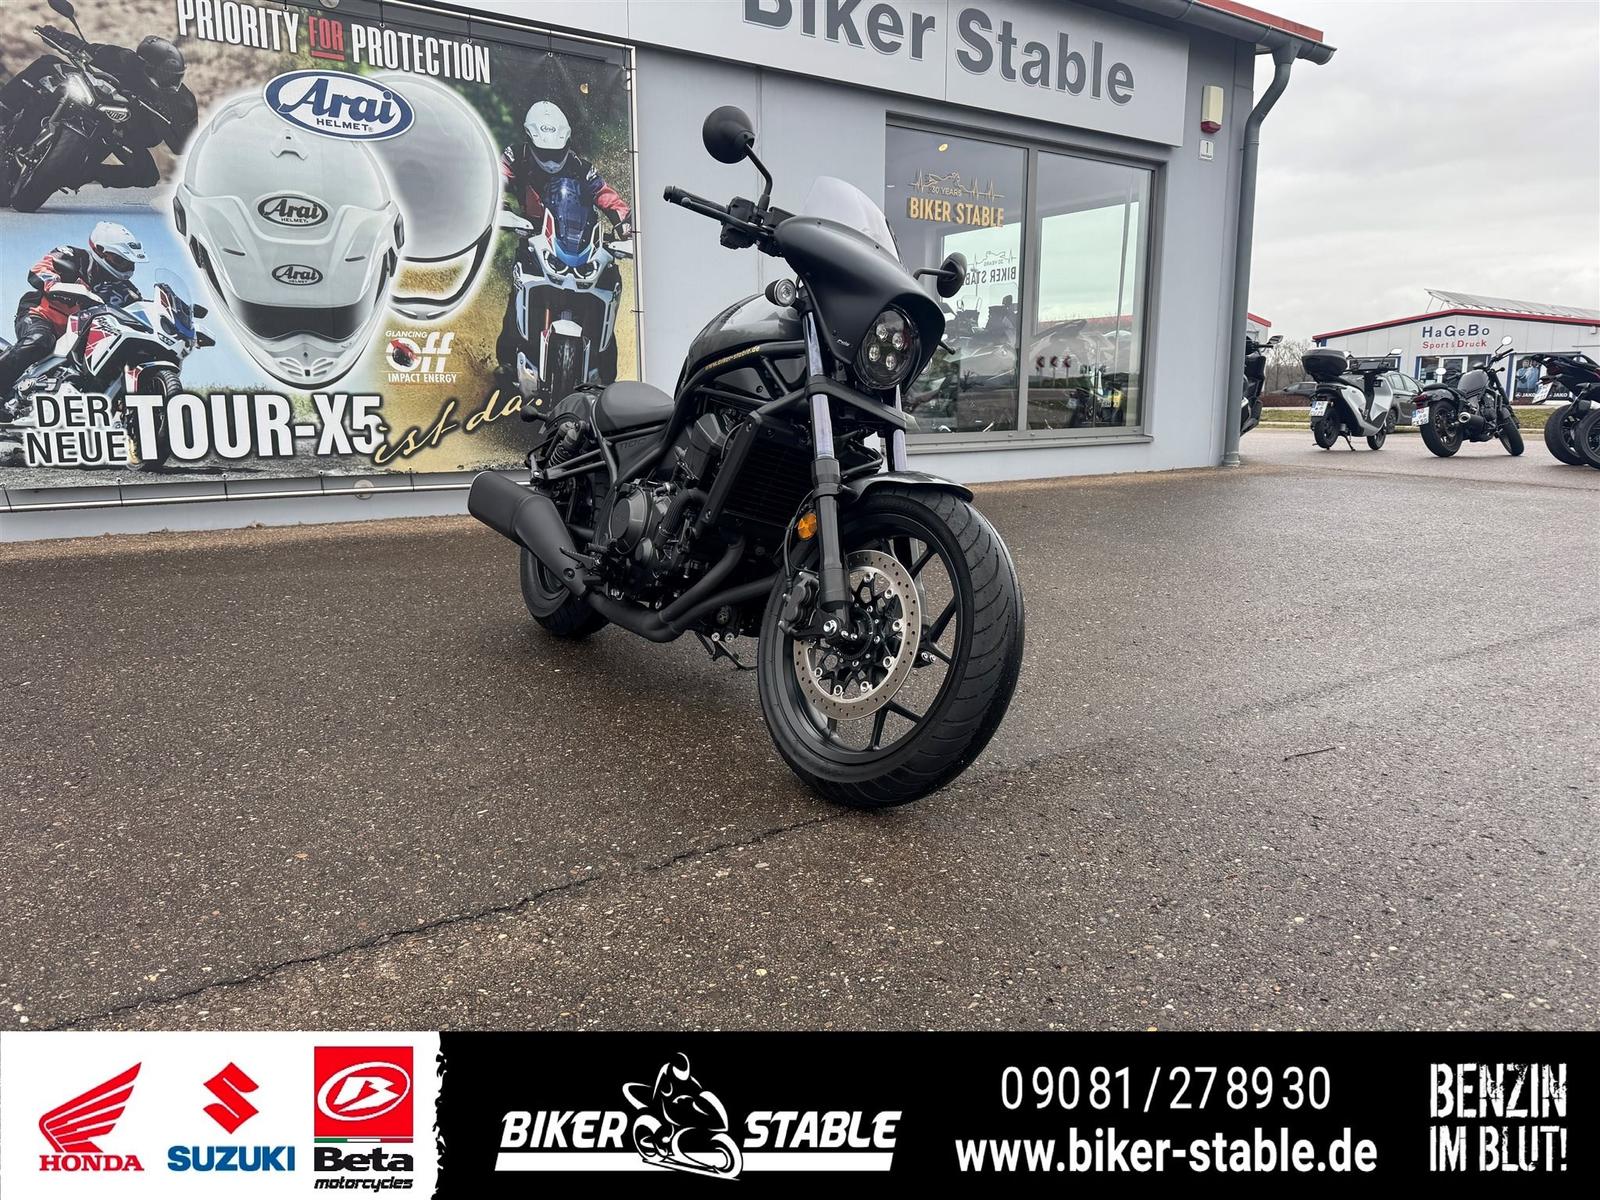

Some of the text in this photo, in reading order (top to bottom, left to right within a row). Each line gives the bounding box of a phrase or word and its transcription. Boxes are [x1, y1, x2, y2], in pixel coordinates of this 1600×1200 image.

[177, 0, 491, 84] PRIORITY FOR PROTECTION
[955, 7, 1135, 106] Stable
[278, 78, 397, 124] Arai
[316, 118, 369, 132] HELMET
[941, 186, 961, 197] YEARS
[264, 199, 320, 220] Arai
[908, 197, 1004, 228] BIKER STABLE
[276, 265, 318, 280] Arai
[385, 330, 427, 339] GLANCING
[1422, 324, 1490, 338] HaGeBo
[1423, 341, 1449, 349] Sport
[1457, 339, 1487, 348] Druck
[388, 373, 457, 383] IMPACT ENERGY
[35, 395, 110, 427] DER
[126, 394, 384, 461] TOUR-X5
[374, 401, 458, 463] ist
[26, 430, 127, 463] NEUE
